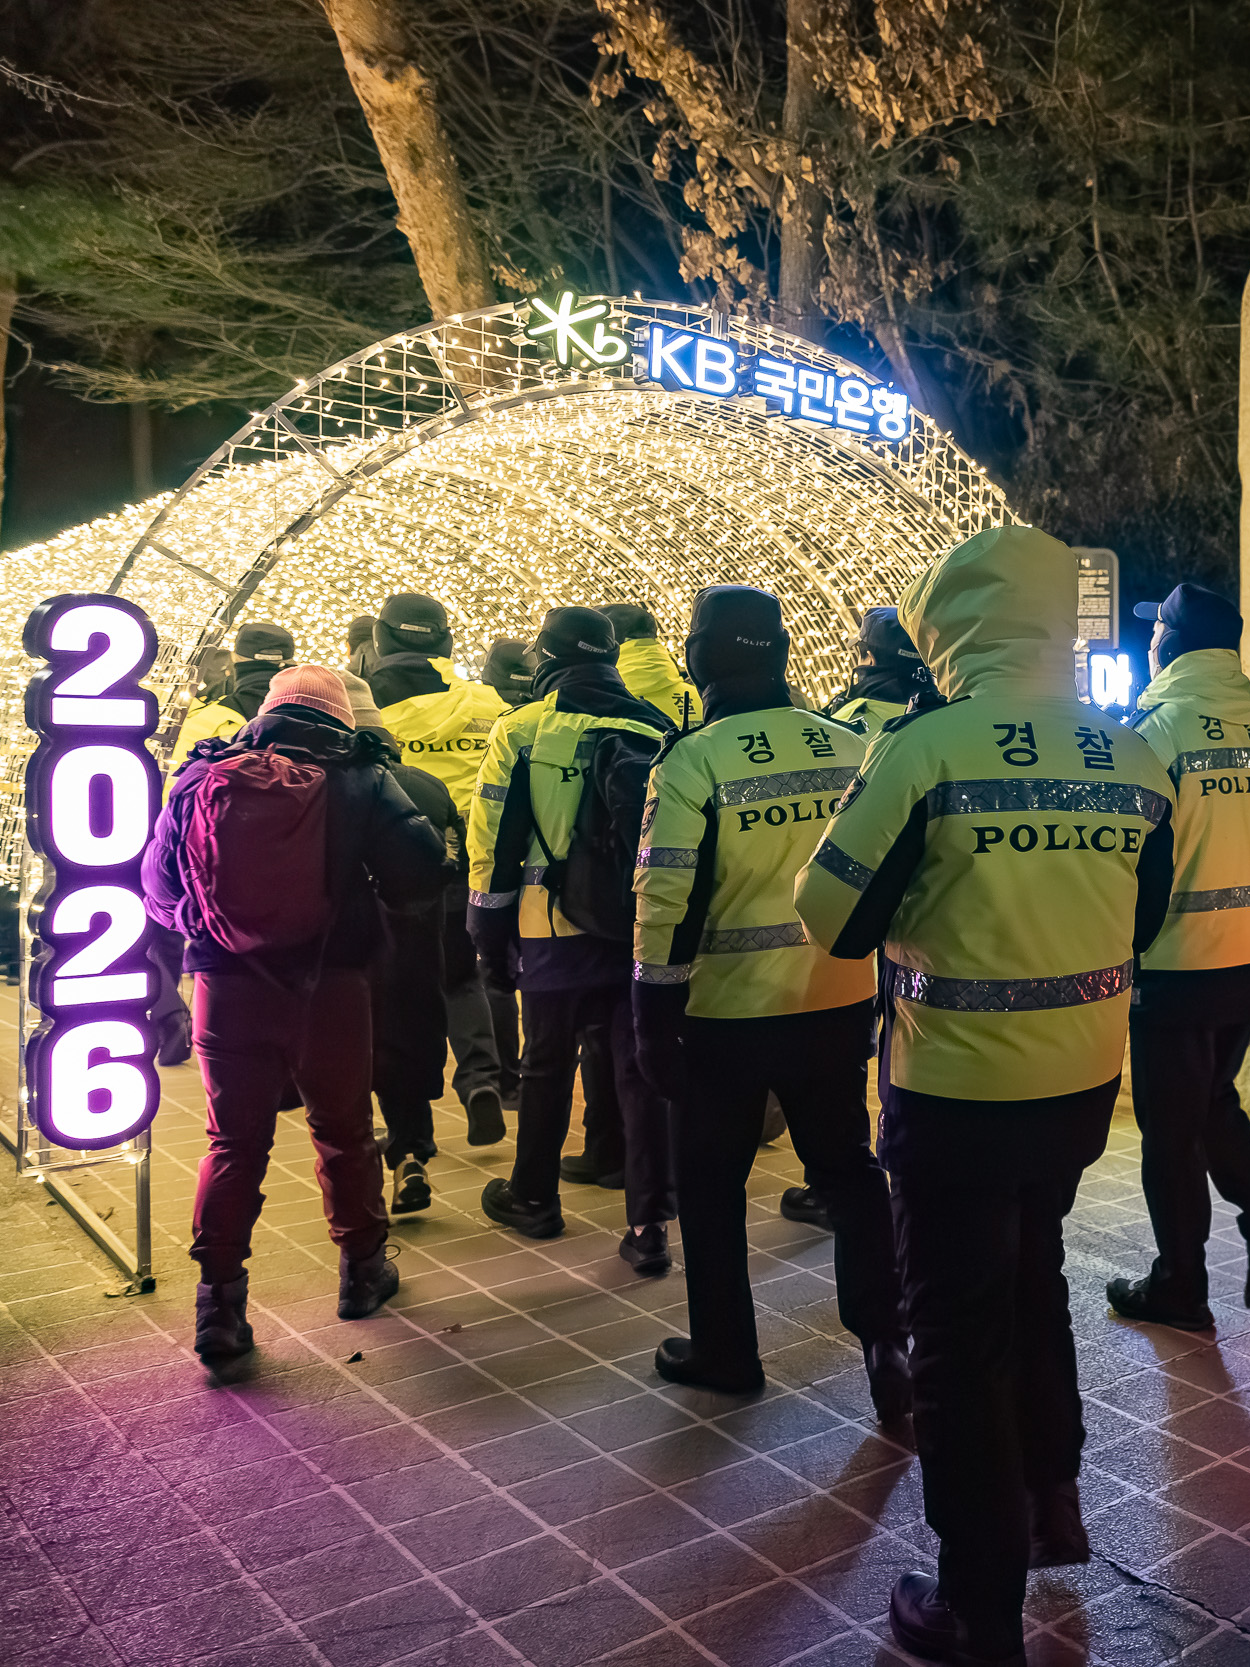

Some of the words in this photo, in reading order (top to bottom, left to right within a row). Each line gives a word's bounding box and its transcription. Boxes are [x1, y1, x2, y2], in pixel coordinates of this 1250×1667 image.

[651, 327, 737, 394] KB
[754, 357, 909, 440] 국민은행
[737, 727, 837, 764] 경찰
[993, 721, 1116, 771] 경찰
[970, 824, 1142, 854] POLICE
[50, 604, 149, 1140] 2026
